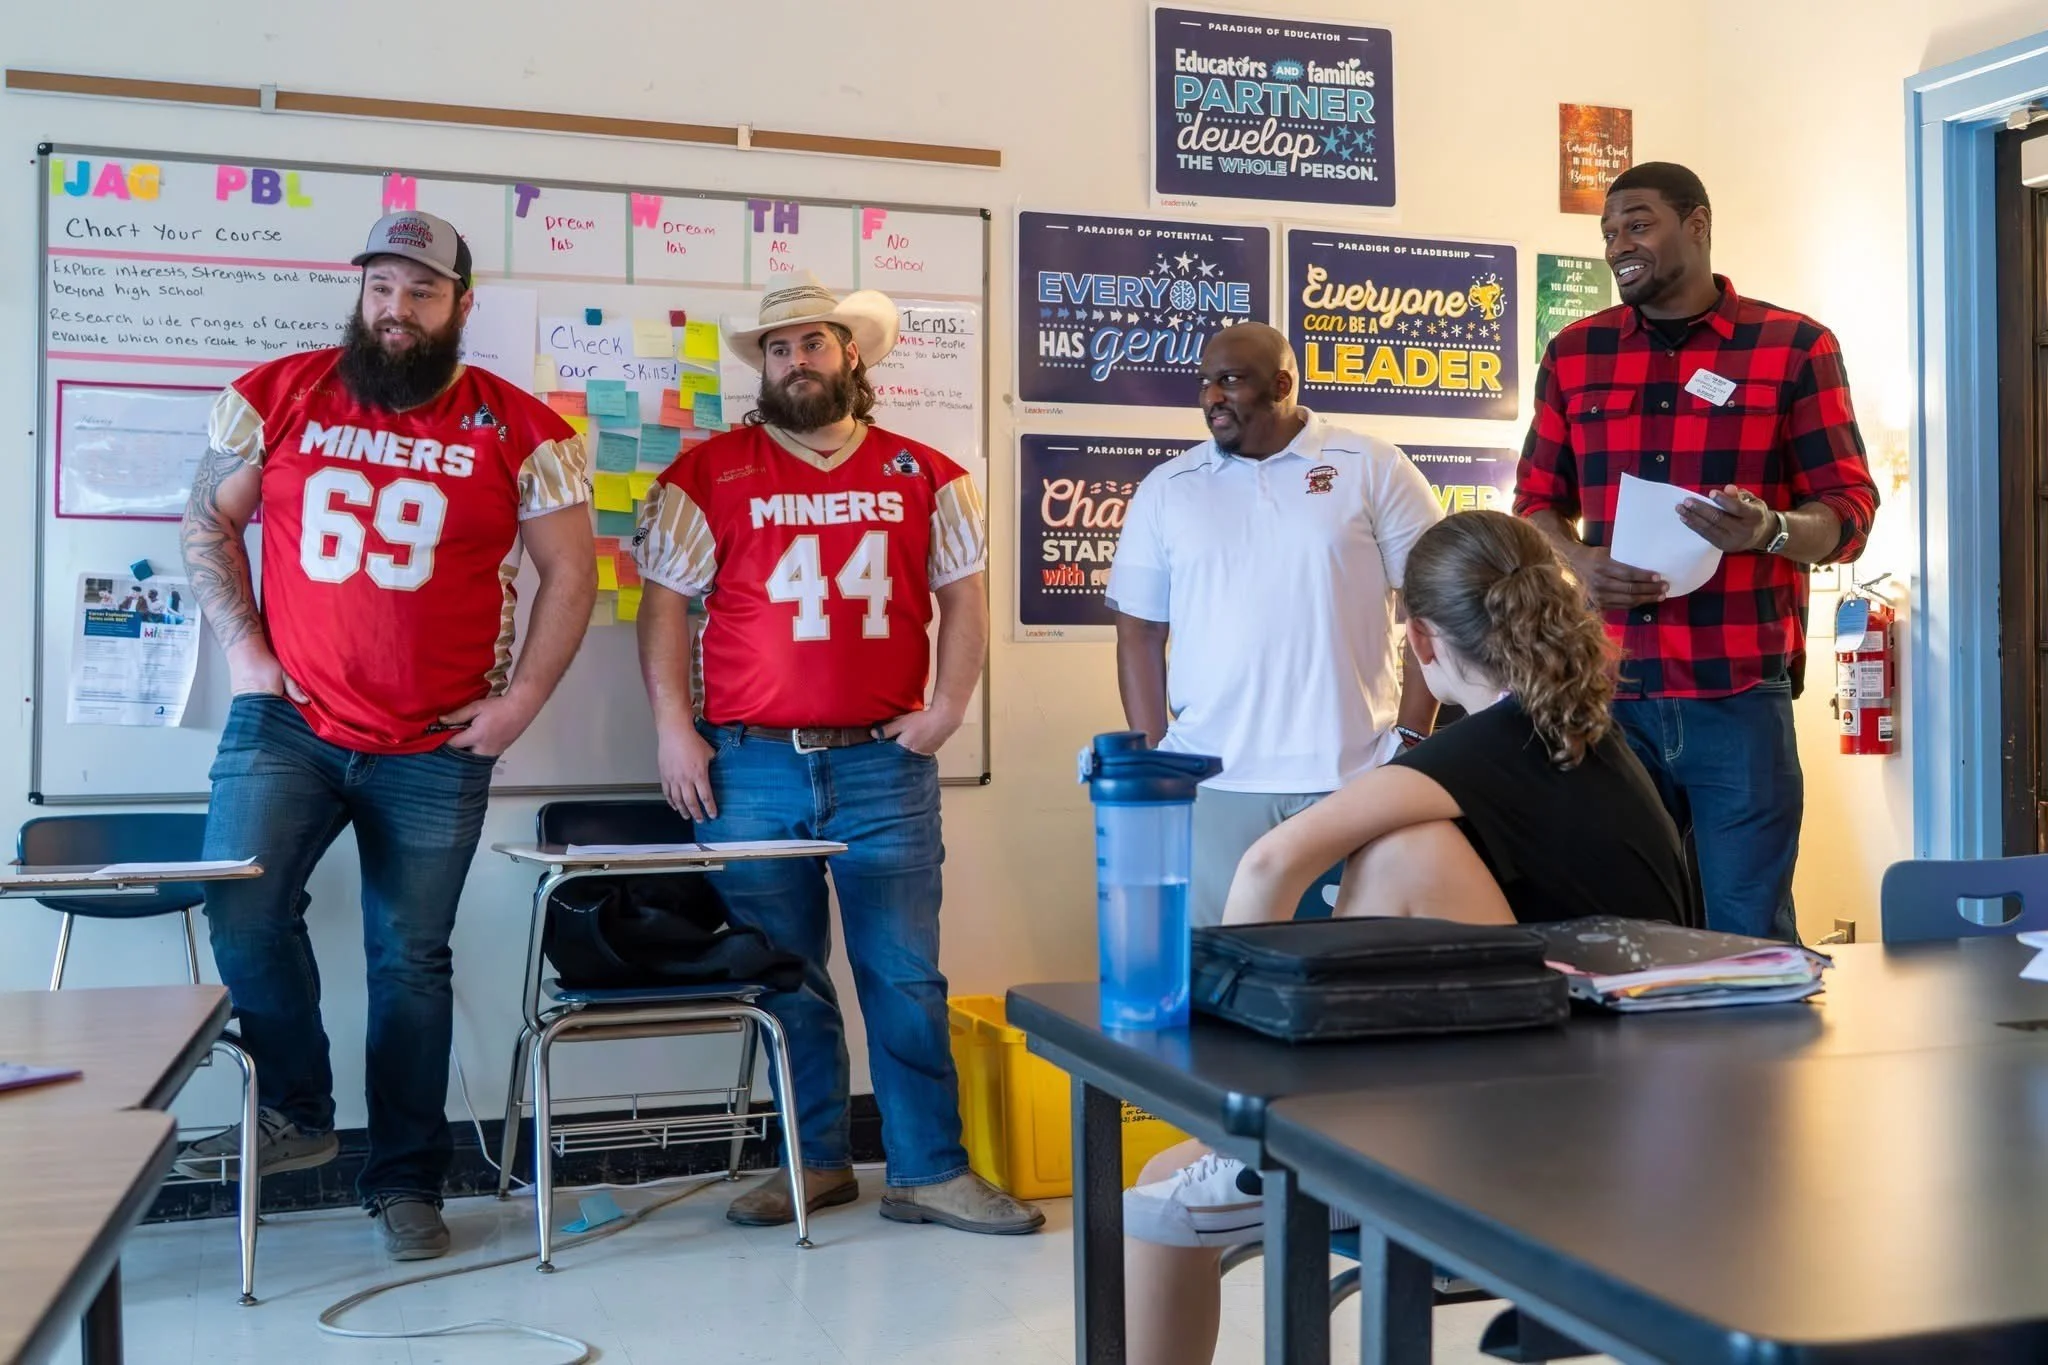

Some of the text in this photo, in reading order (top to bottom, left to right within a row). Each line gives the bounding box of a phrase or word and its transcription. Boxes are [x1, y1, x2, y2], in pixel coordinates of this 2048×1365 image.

[1208, 22, 1341, 42] PARADIGM OF EDUCATION
[1275, 66, 1299, 77] AND
[1307, 59, 1375, 87] families
[1174, 75, 1376, 124] PARTNER
[1176, 112, 1193, 124] TO
[1176, 112, 1321, 173] develop
[1176, 153, 1378, 182] THE WHOLE PERSON.
[50, 158, 313, 209] IJAG PBL
[382, 172, 887, 240] M T W TH F
[66, 218, 282, 242] Chart Your Course
[545, 215, 595, 231] Dream
[663, 222, 716, 236] Dream
[1077, 225, 1214, 242] PARADIGM OF POTENTIAL
[551, 237, 575, 251] lab
[666, 241, 687, 255] lab
[1338, 242, 1470, 259] PARADIGM OF LEADERSHIP
[273, 271, 300, 283] and
[769, 258, 795, 273] Day
[53, 280, 105, 297] beyond
[115, 283, 151, 301] high
[1302, 263, 1468, 329] Everyone
[50, 308, 133, 324] Research
[191, 317, 244, 331] ranges
[253, 316, 267, 329] of
[903, 310, 965, 333] Terms:
[1303, 313, 1379, 335] can BE A
[52, 330, 109, 344] evaluate
[165, 336, 198, 346] ones
[204, 335, 238, 346] relate
[244, 336, 256, 345] to
[550, 325, 623, 356] Check
[1039, 320, 1203, 382] HAS geni
[559, 364, 598, 378] our
[1305, 342, 1503, 391] LEADER
[299, 419, 476, 478] MINERS
[1087, 446, 1188, 457] PARADIGM OF CHA
[1411, 454, 1472, 464] MOTIVATION
[750, 491, 905, 530] MINERS
[1041, 478, 1132, 529] Cha
[300, 466, 449, 592] 69
[1042, 539, 1118, 563] STAR
[765, 530, 893, 642] 44
[1042, 563, 1085, 587] with
